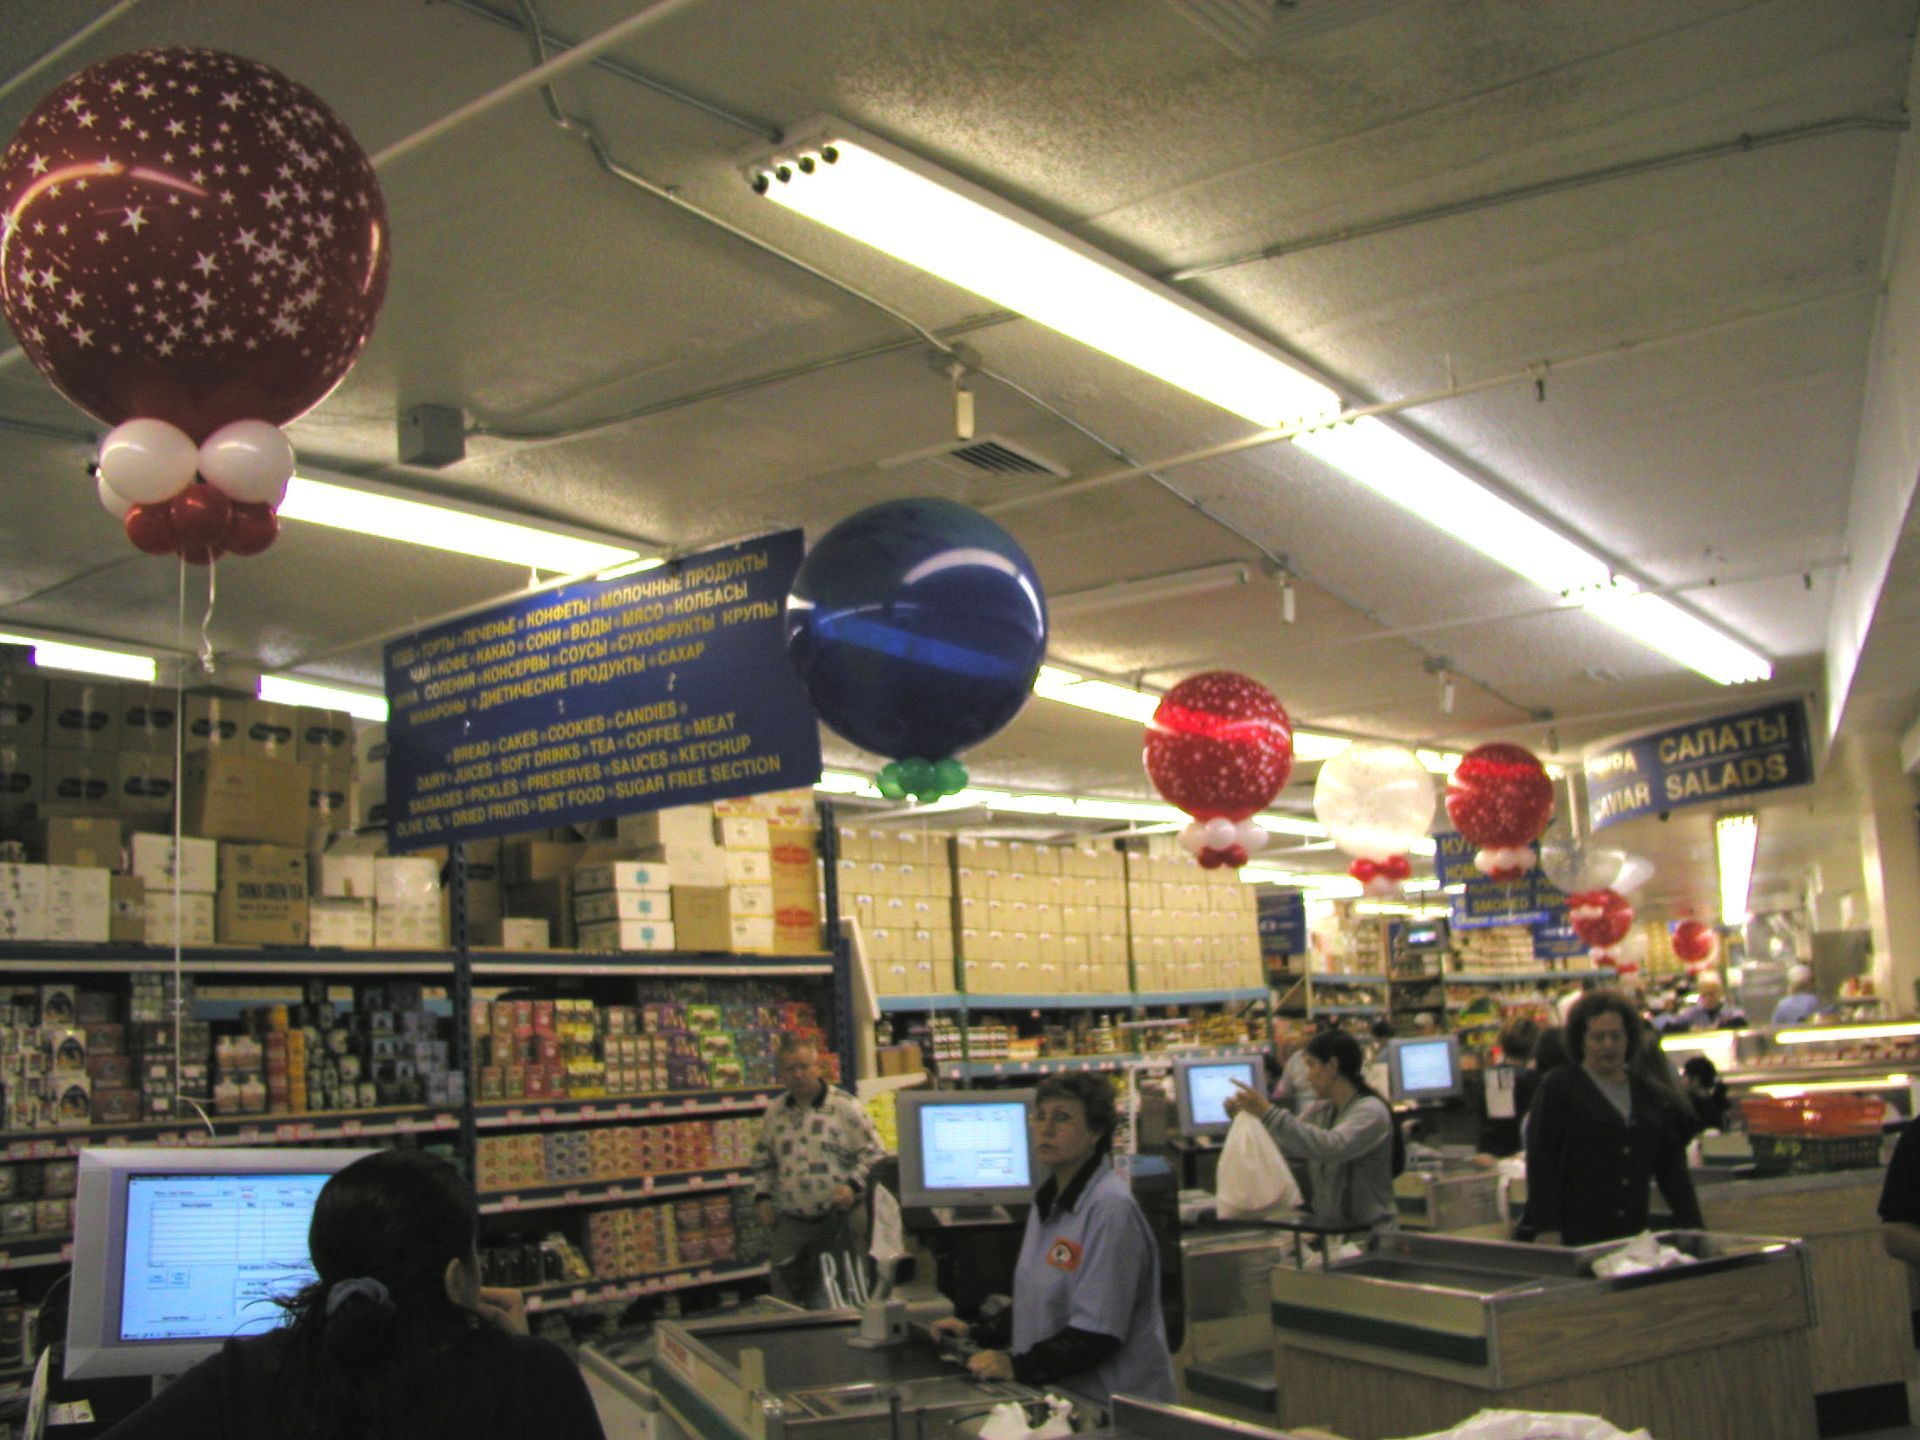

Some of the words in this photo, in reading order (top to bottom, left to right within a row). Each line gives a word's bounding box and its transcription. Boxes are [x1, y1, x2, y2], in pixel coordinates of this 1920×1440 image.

[410, 660, 432, 683] ЧАЙ
[437, 654, 469, 676] КОФЕ
[476, 640, 516, 664] КАКАО
[526, 628, 562, 651] СОКИ
[571, 616, 612, 641] ВОДЫ
[623, 603, 665, 627] МЯСО
[674, 581, 748, 615] КОЛБАСЫ
[464, 616, 516, 645] ПЕЧЕНЬЕ
[526, 598, 591, 628] КОНФЕТЫ
[601, 577, 683, 609] МОЛОЧНЫЕ
[686, 552, 768, 588] ПРОДУКТЫ
[425, 672, 476, 700] СОЛЕНИЯ
[483, 653, 550, 684] КОНСЕРВЫ
[560, 640, 608, 666] СОУСЫ
[618, 613, 715, 651] СУХОФРУКТЫ
[722, 601, 778, 627] КРУПЫ
[479, 672, 567, 711] ДИЕТИЧЕСКИЕ
[571, 655, 645, 686] ПРОДУКТЫ
[658, 641, 705, 666] САХАР
[417, 772, 447, 792] DAIRY
[455, 761, 493, 783] JUICES
[501, 752, 531, 774] SOFT
[534, 743, 579, 767] DRINKS
[590, 737, 616, 756] TEA
[626, 723, 682, 749] COFFEE
[694, 712, 736, 736] MEAT
[453, 740, 491, 764] BREAD
[500, 730, 538, 753] CAKES
[548, 715, 605, 742] COOKIES
[615, 700, 677, 729] CANDIES
[1659, 714, 1788, 765] САЛАТЫ
[396, 818, 424, 838] OLIVE
[425, 814, 443, 832] OIL
[452, 806, 486, 828] DRIED
[488, 798, 530, 820] FRUITS
[538, 792, 565, 813] DIET
[568, 786, 605, 807] FOOD
[615, 775, 665, 799] SUGAR
[668, 767, 706, 790] FREE
[711, 753, 781, 783] SECTION
[409, 790, 463, 815] SAUSAGES
[468, 779, 519, 802] PICKLES
[527, 763, 602, 791] PRESERVES
[611, 750, 668, 776] SAUCES
[679, 734, 751, 763] KETCHUP
[1665, 753, 1788, 801] SALADS
